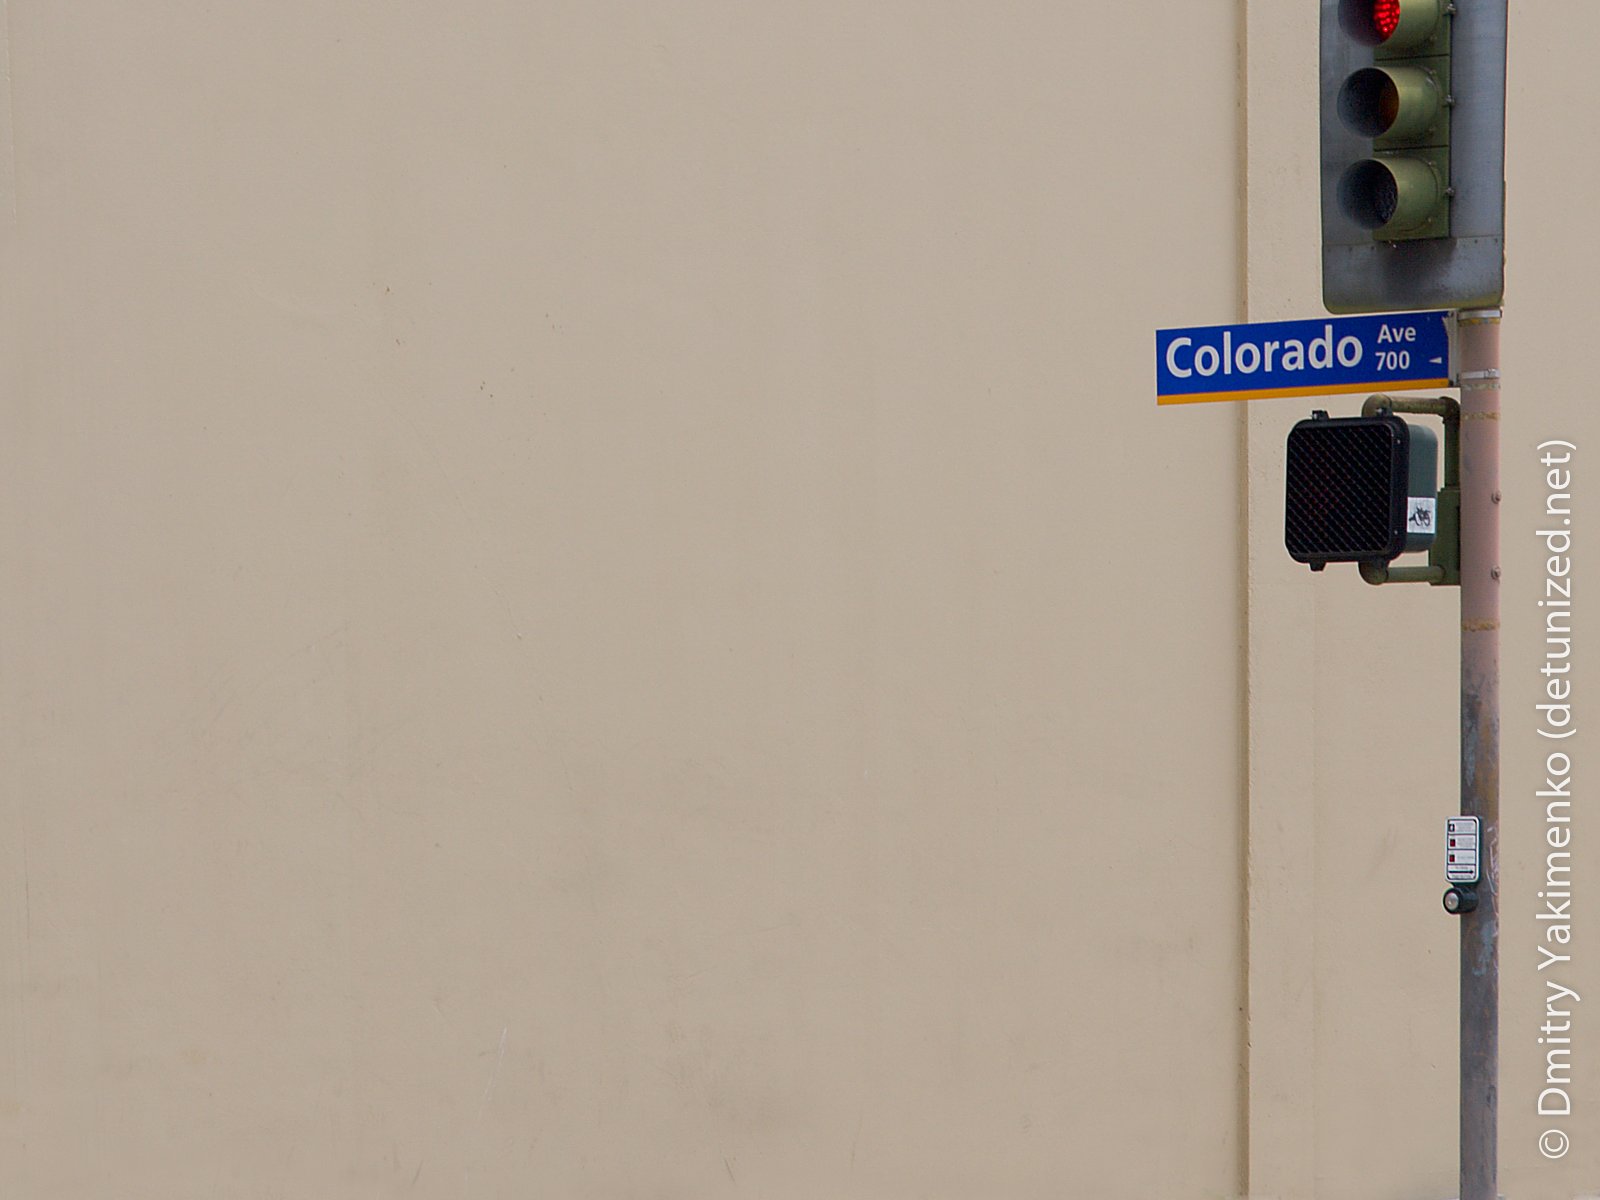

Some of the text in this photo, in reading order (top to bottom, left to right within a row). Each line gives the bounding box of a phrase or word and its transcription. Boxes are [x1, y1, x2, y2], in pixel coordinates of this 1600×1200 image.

[1165, 324, 1417, 379] Colorado Ave
[1374, 350, 1411, 371] 700
